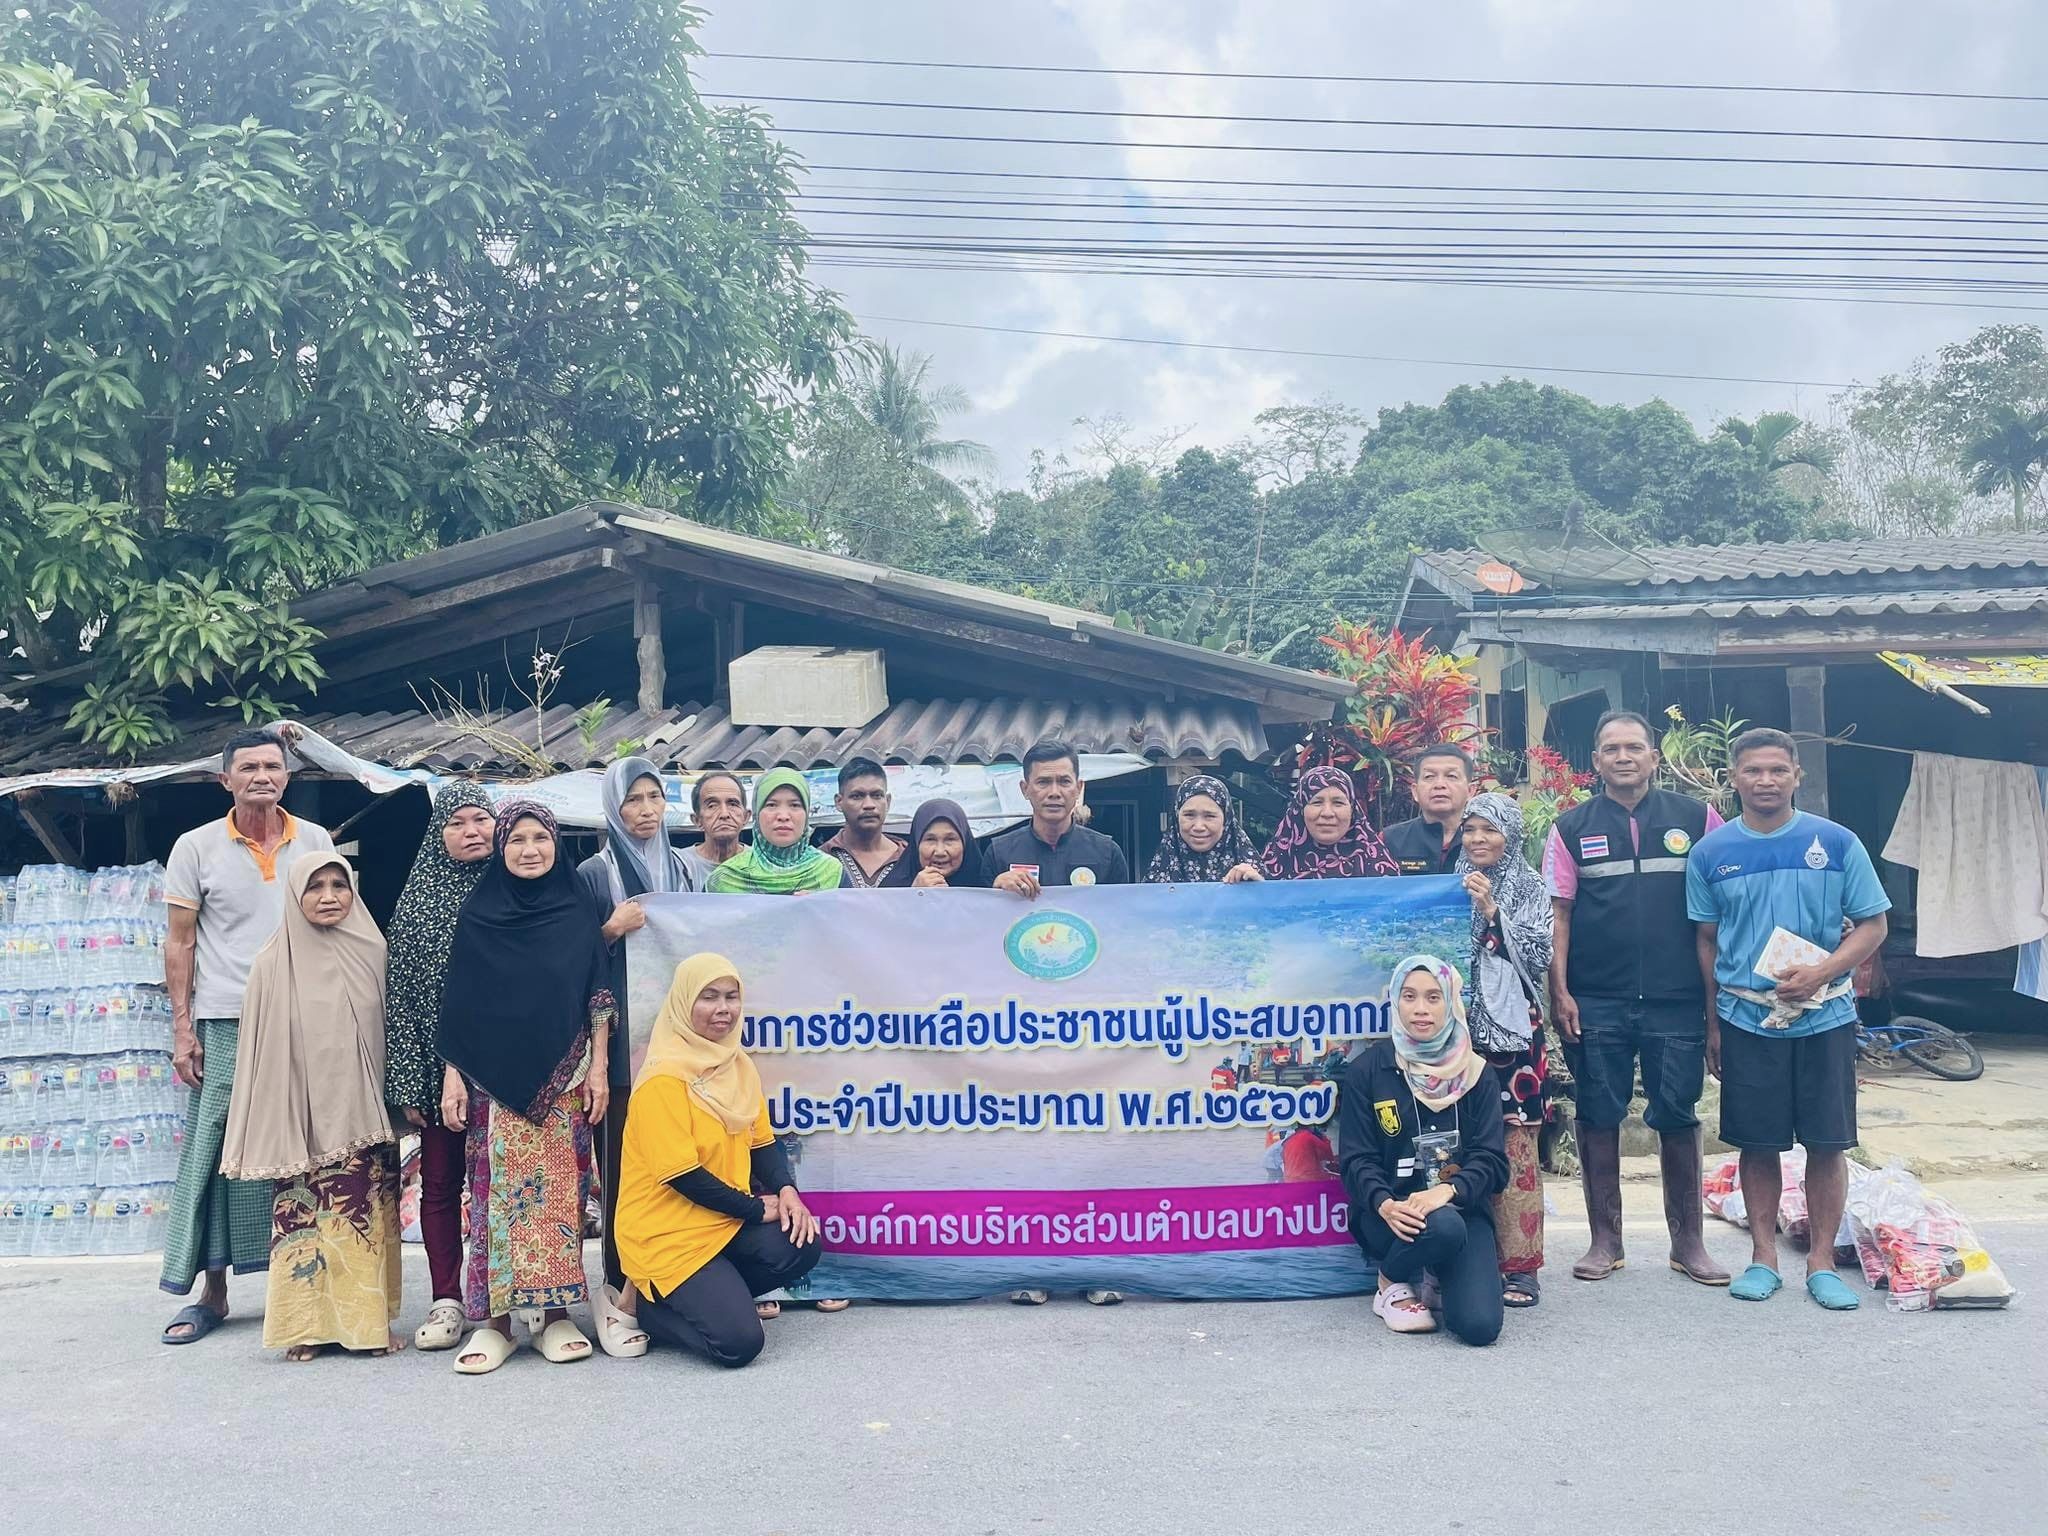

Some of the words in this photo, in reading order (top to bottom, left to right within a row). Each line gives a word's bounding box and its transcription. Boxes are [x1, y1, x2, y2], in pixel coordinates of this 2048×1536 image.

[767, 1080, 1105, 1130] ประจำปีงบประมาณ
[1118, 1086, 1333, 1127] พ.ศ.๒๕๖๗
[814, 1193, 1350, 1246] องค์การบริหารส่วนตำบลบางปอ
